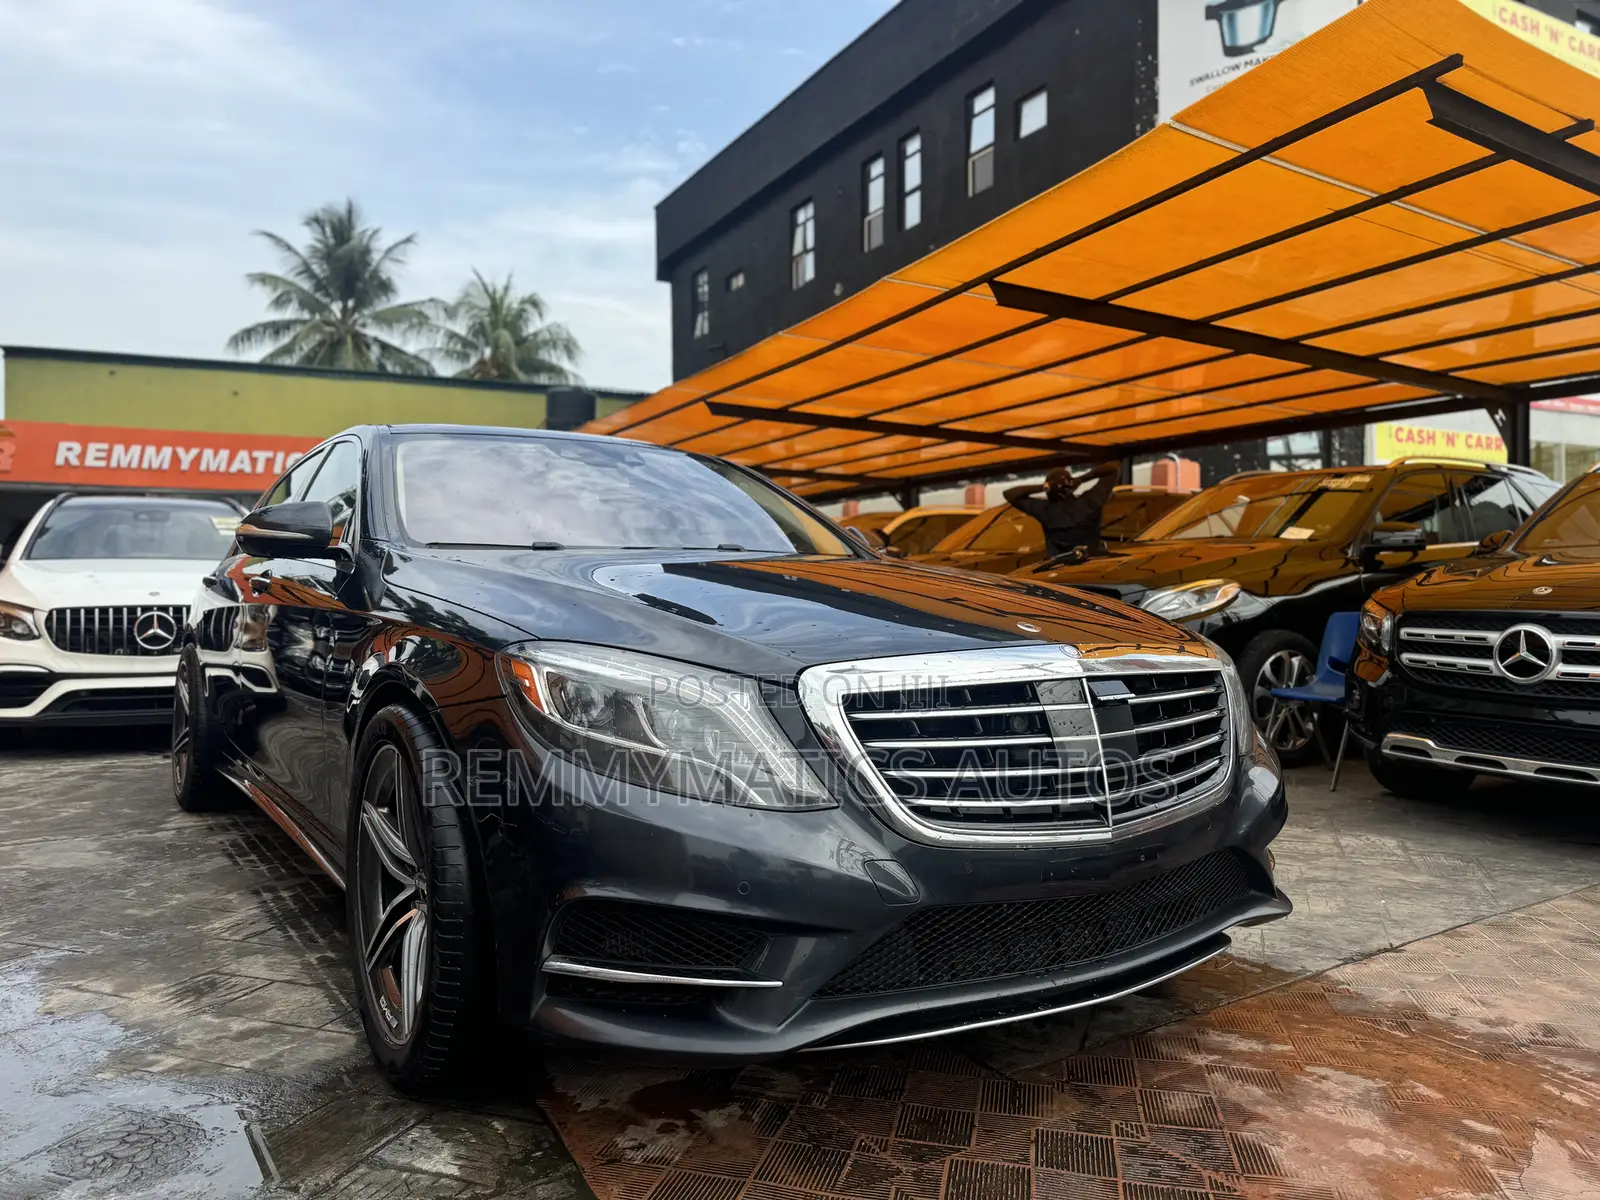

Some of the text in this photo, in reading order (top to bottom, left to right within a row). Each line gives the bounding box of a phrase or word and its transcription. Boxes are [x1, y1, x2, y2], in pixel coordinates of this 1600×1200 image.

[1498, 7, 1540, 36] CASH
[1189, 61, 1241, 87] SWALLOW
[1243, 55, 1272, 68] MAK
[1395, 426, 1436, 446] CASH
[1441, 431, 1460, 448] 'N'
